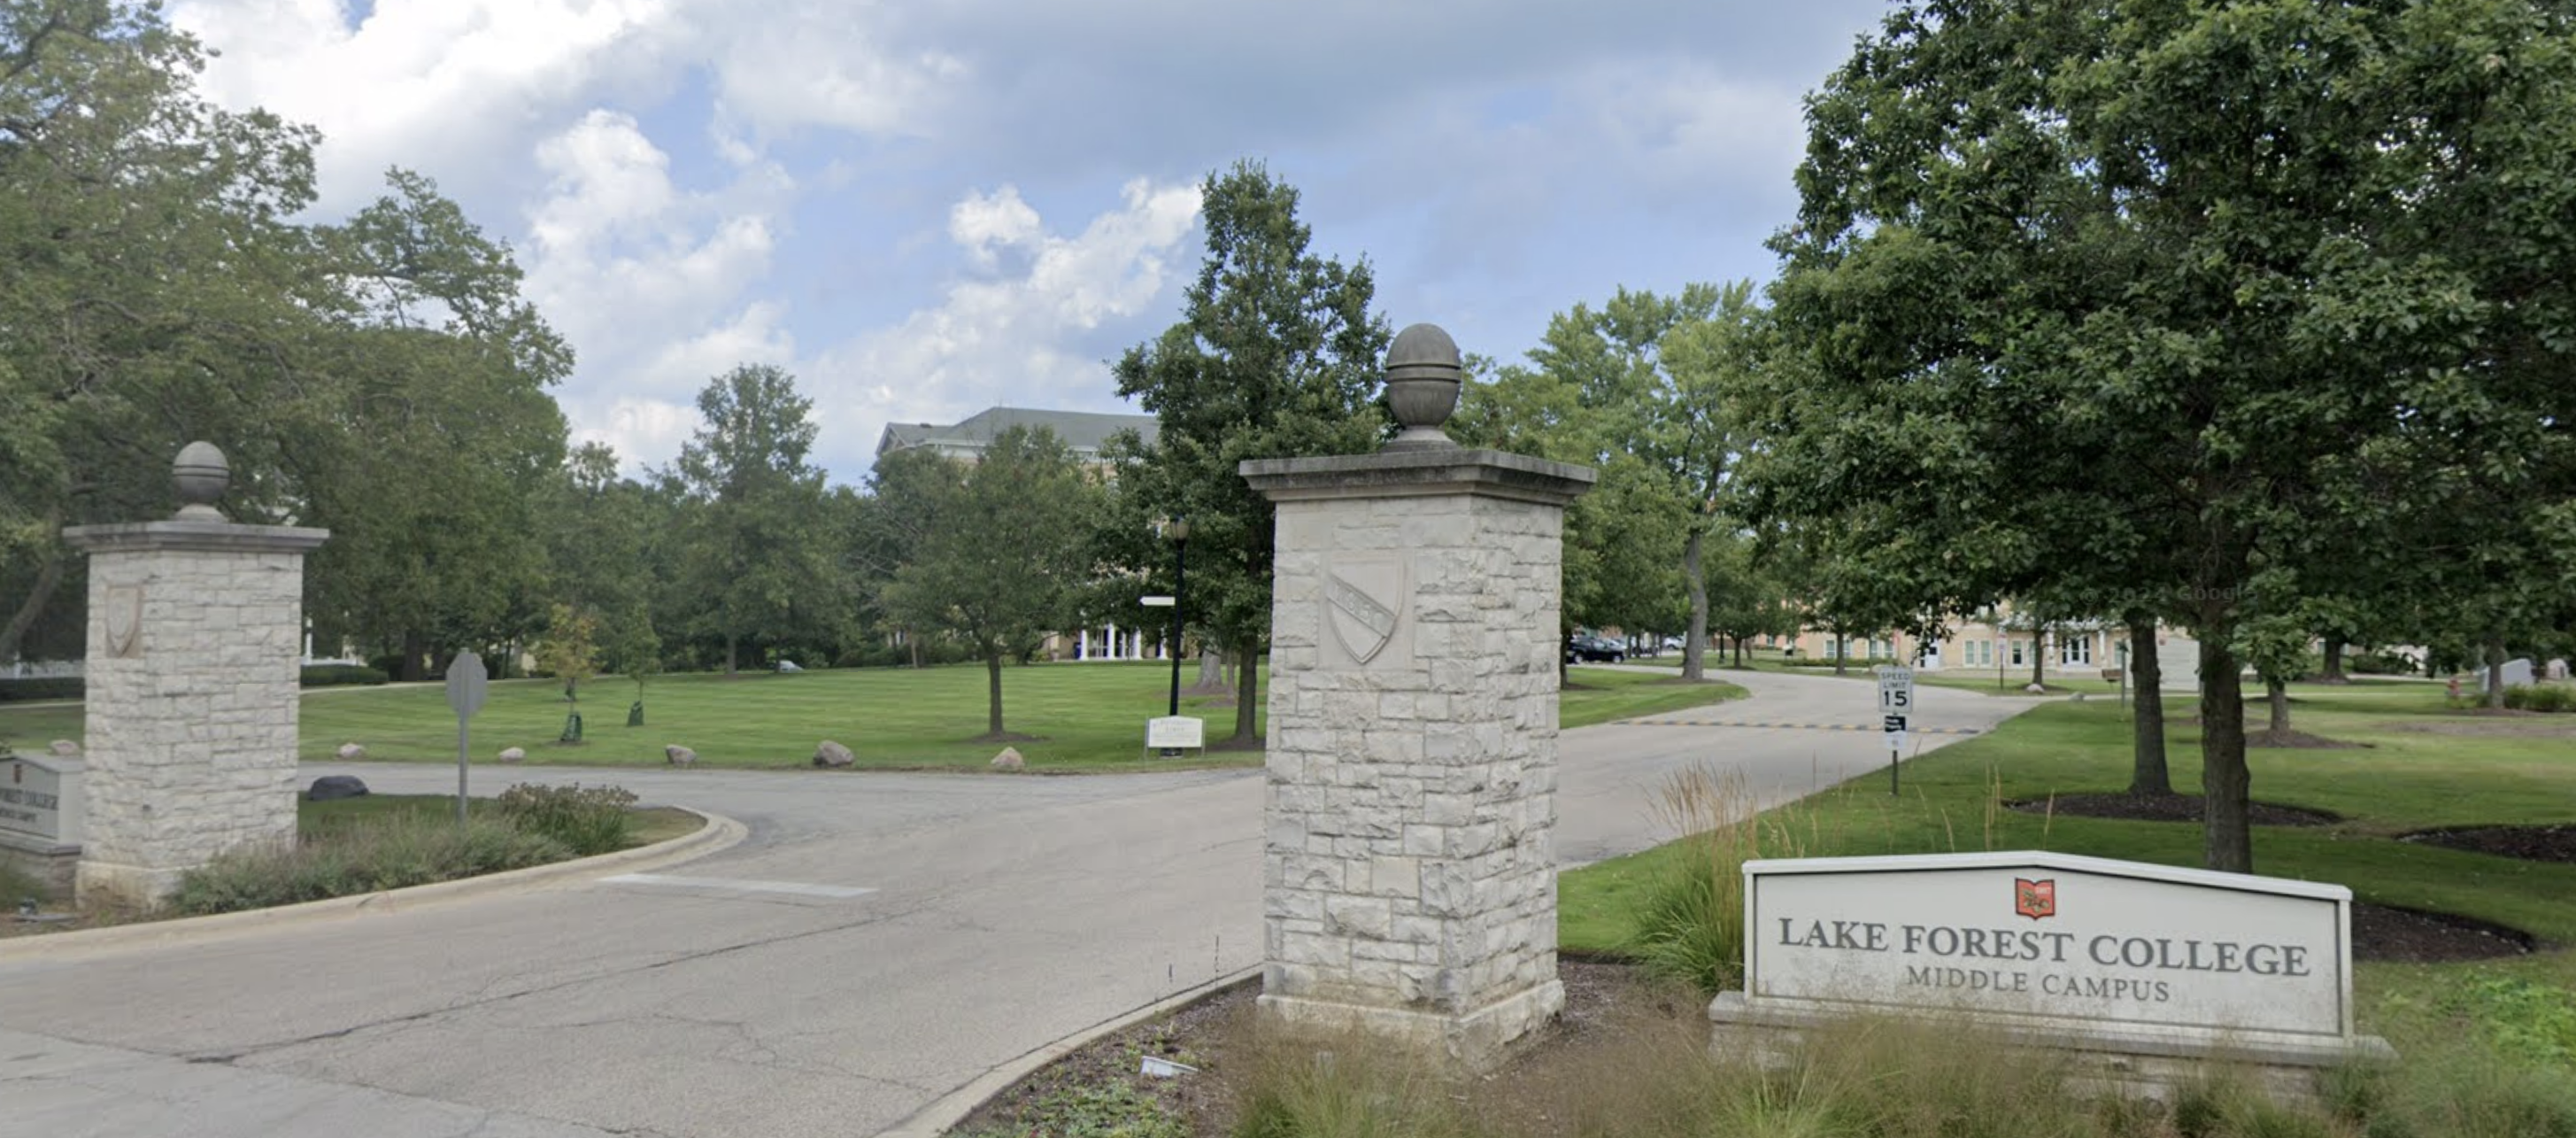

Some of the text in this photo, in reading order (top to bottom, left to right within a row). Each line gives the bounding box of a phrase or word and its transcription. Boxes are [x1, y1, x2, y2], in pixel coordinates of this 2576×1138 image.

[1884, 690, 1907, 707] 15
[1778, 917, 2310, 977] LAKE FOREST COLLEGE
[1907, 965, 2170, 1003] MIDDLE CAMPUS
